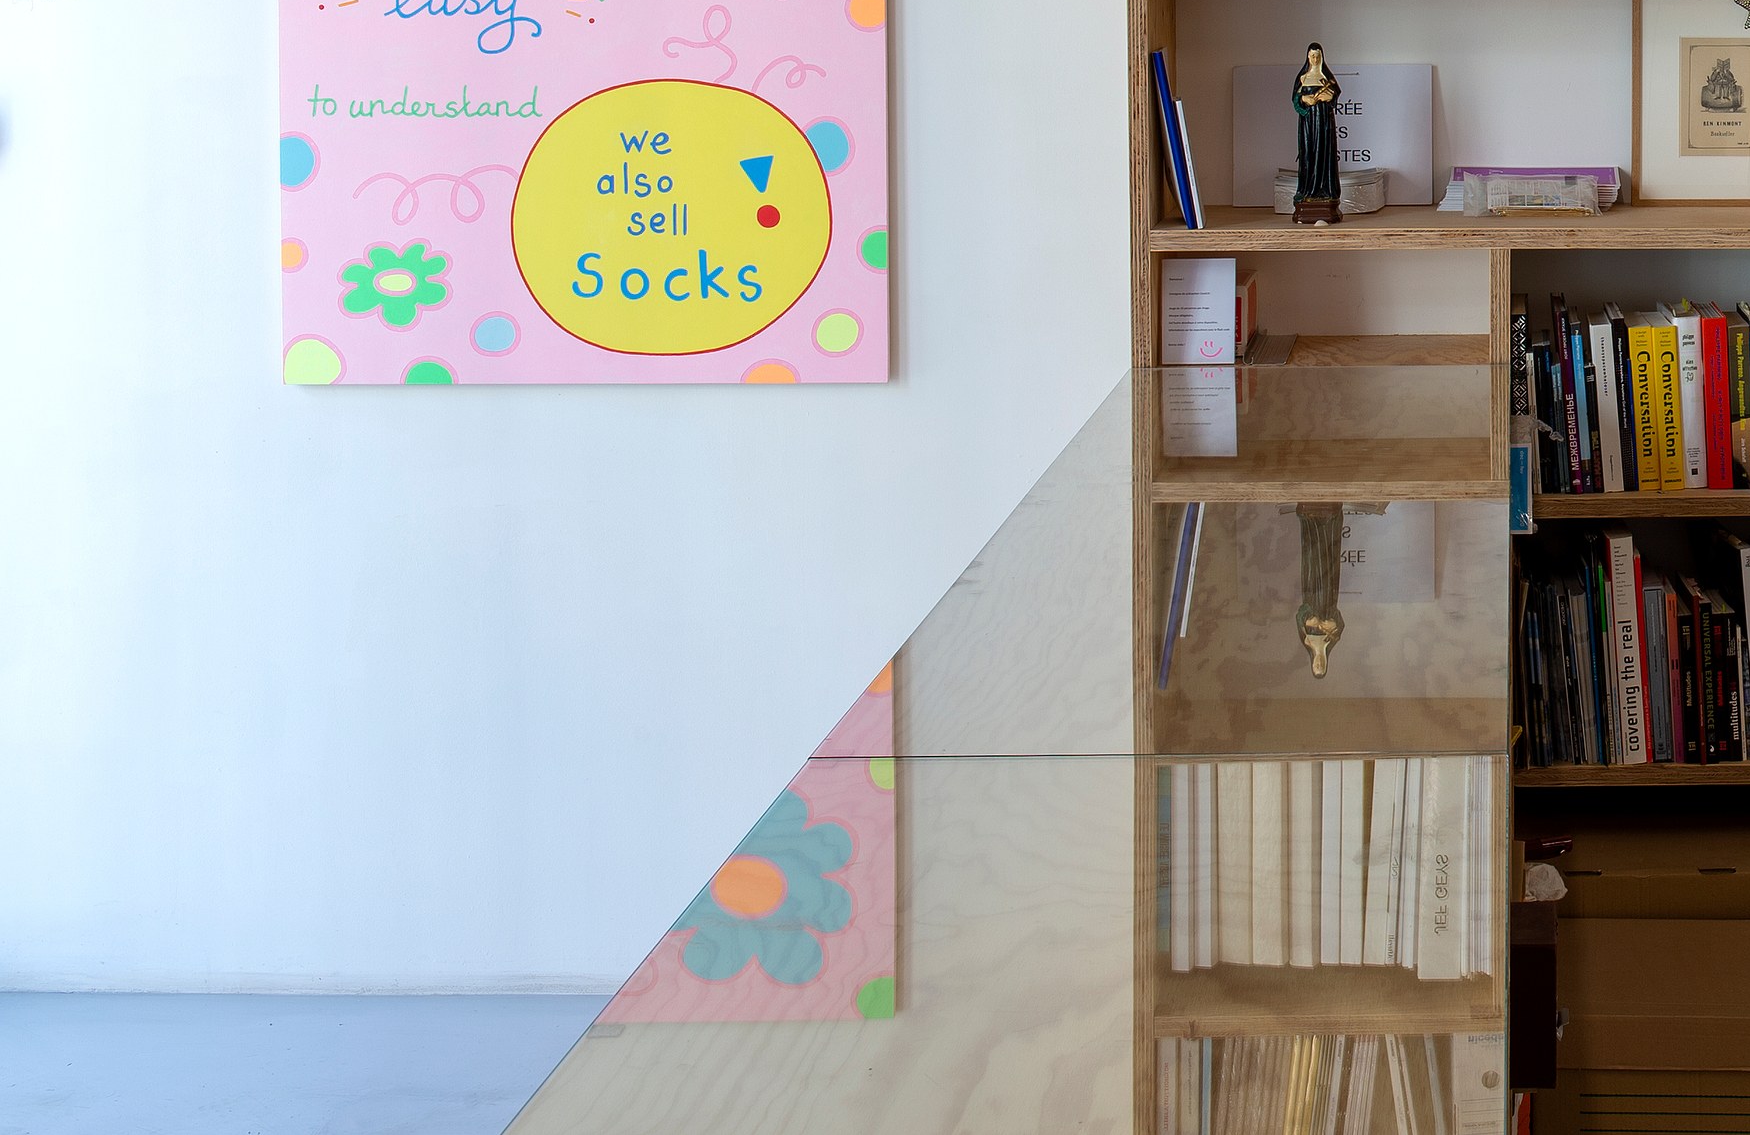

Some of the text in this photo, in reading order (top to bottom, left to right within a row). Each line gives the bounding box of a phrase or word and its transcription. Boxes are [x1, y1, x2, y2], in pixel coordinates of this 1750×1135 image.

[308, 87, 542, 117] to understand
[620, 131, 672, 155] we
[597, 163, 673, 195] also
[627, 205, 688, 236] sell
[572, 250, 763, 302] Socks
[1636, 350, 1653, 458] Conversation
[1659, 350, 1677, 458] Conversation
[1565, 393, 1580, 471] МЕЖВРЕМЕНЬЕ
[1618, 618, 1640, 752] covering the real
[1702, 612, 1715, 730] UNIVERSAL EXPERIENCE
[1731, 691, 1739, 741] multitudes
